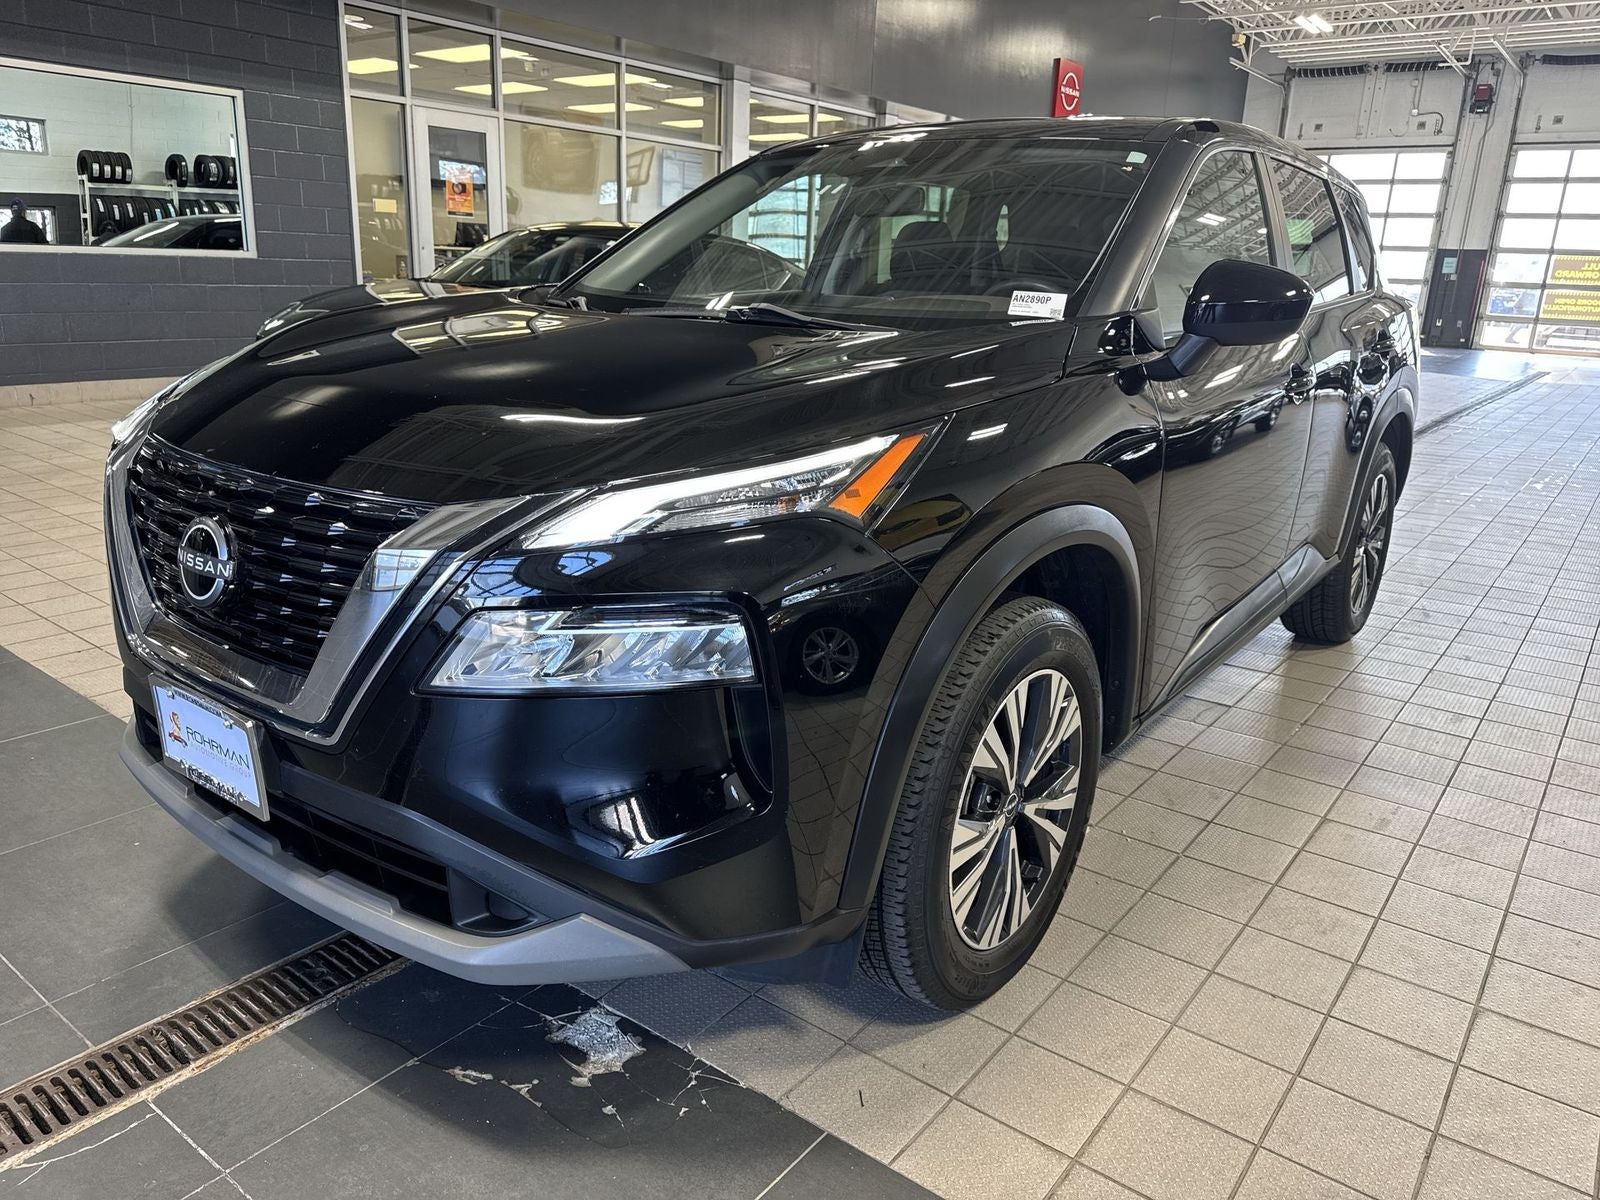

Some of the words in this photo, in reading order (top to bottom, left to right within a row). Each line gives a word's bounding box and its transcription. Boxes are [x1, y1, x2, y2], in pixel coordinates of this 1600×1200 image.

[1061, 85, 1080, 98] NISSAN
[1012, 294, 1052, 304] AN2890P
[178, 547, 230, 578] NISSAN
[186, 726, 250, 770] ROHRMAN
